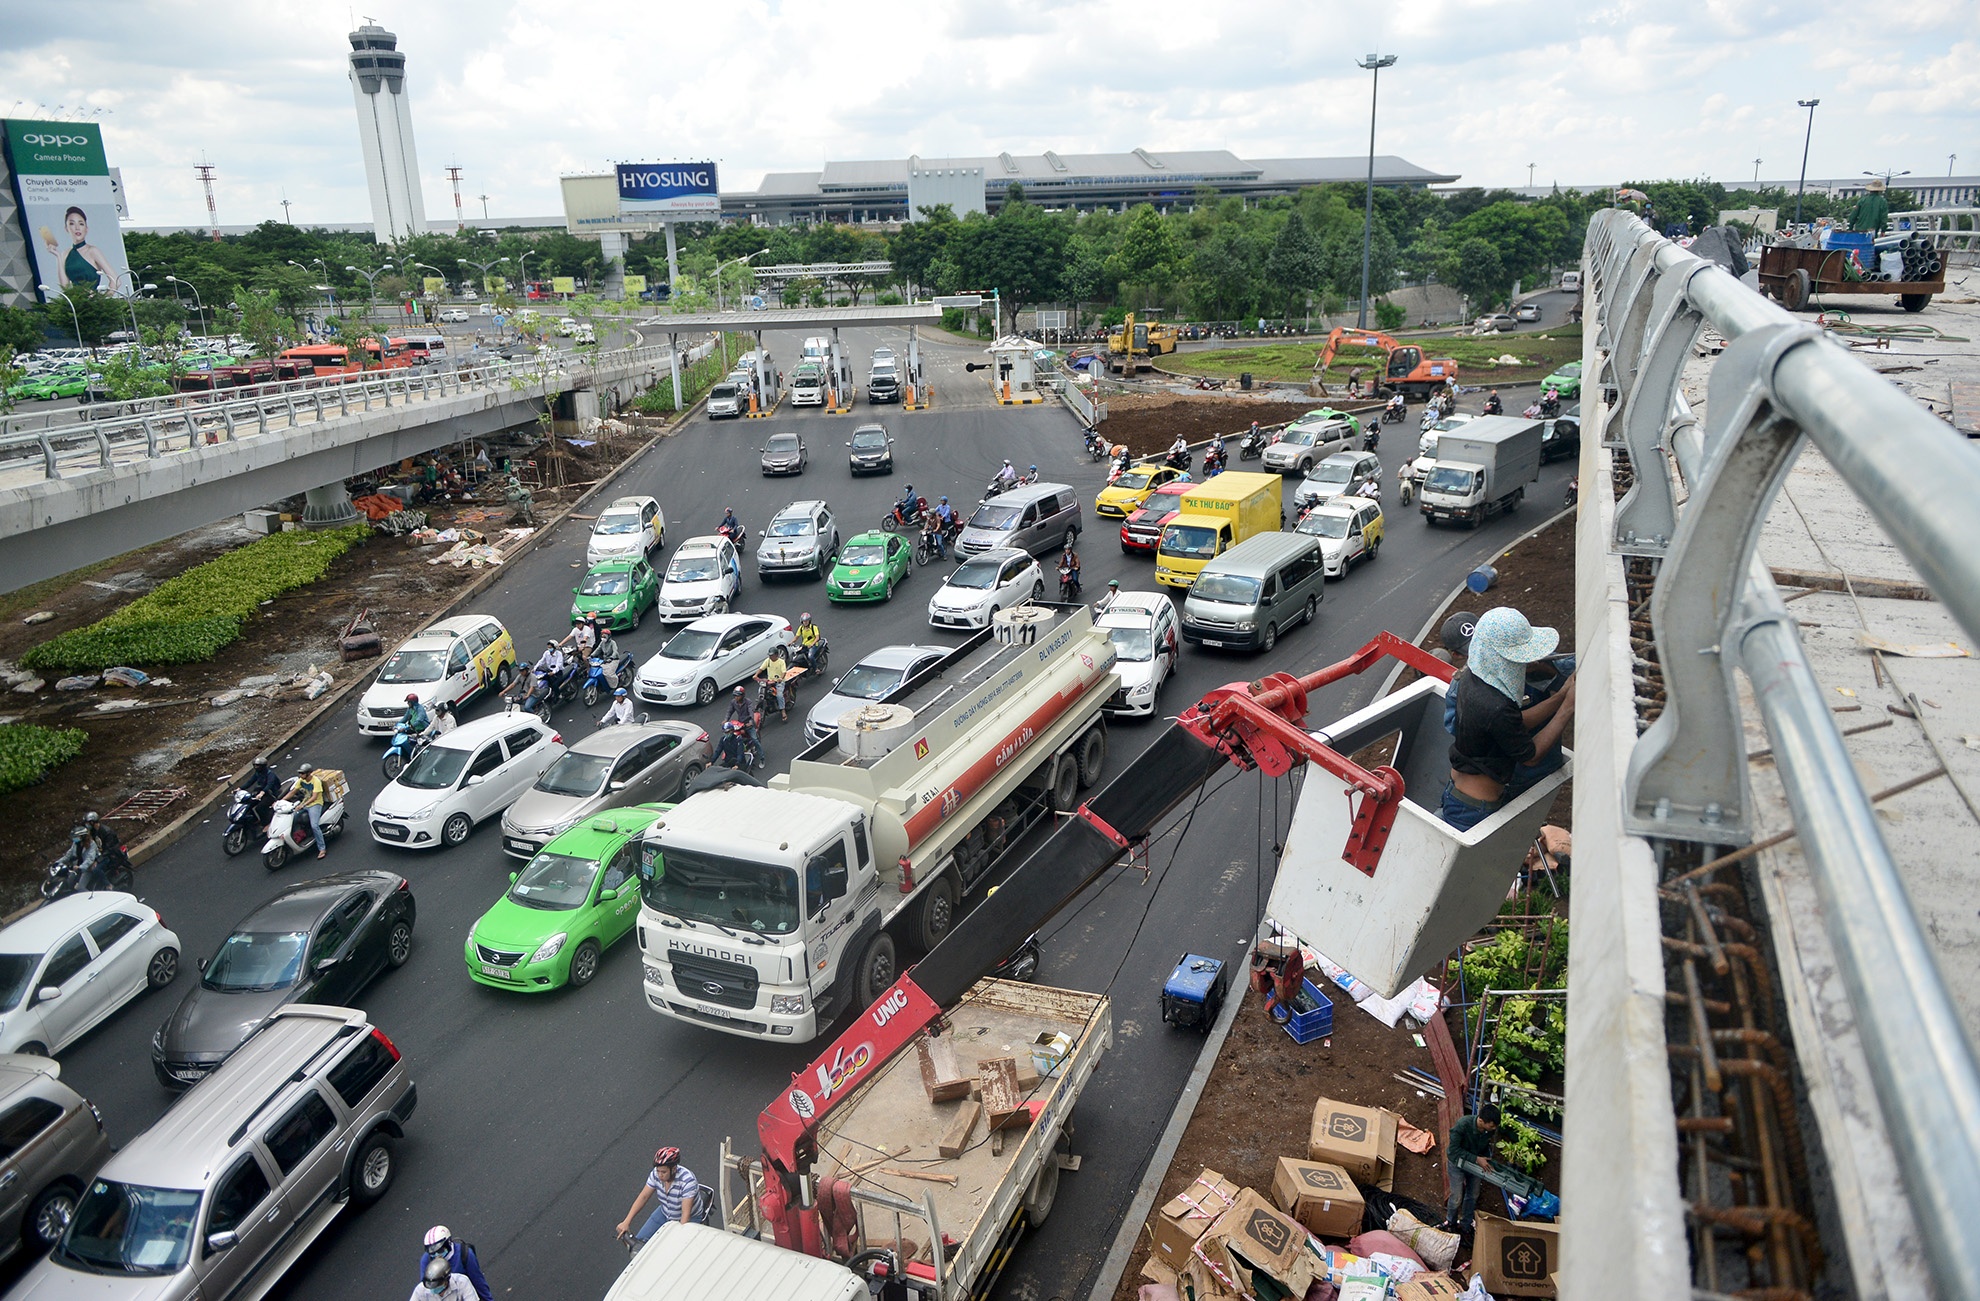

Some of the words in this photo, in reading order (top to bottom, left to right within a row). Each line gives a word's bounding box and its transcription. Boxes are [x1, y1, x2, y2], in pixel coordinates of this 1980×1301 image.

[23, 134, 88, 147] oppo
[34, 153, 61, 161] Camera
[63, 154, 86, 162] Phone
[55, 178, 67, 186] Gia
[68, 179, 88, 187] Selfie
[622, 171, 709, 188] HYOSUNG
[1189, 499, 1198, 507] XE
[921, 791, 933, 804] JET
[669, 939, 753, 965] HYUNDAI
[871, 989, 909, 1028] UNIC
